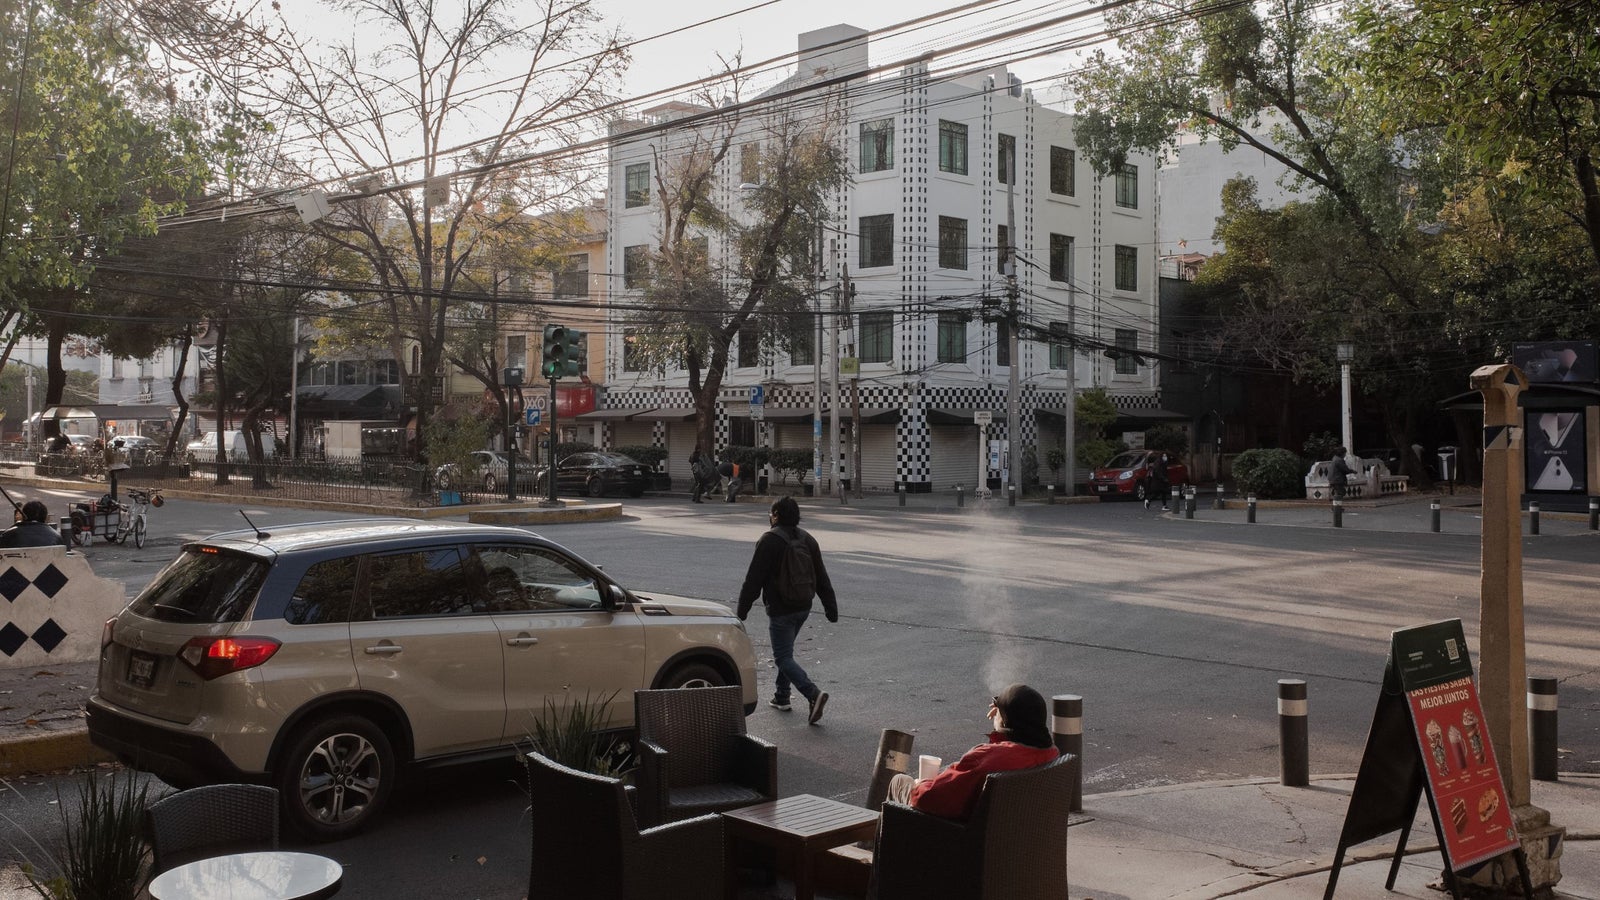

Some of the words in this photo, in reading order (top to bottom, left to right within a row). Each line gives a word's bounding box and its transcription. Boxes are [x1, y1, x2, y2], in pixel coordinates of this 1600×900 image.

[751, 387, 758, 401] P
[1411, 689, 1424, 697] LAS
[1449, 676, 1471, 689] SABEN
[1420, 695, 1444, 710] MEJOR
[1444, 689, 1469, 704] JUNTOS
